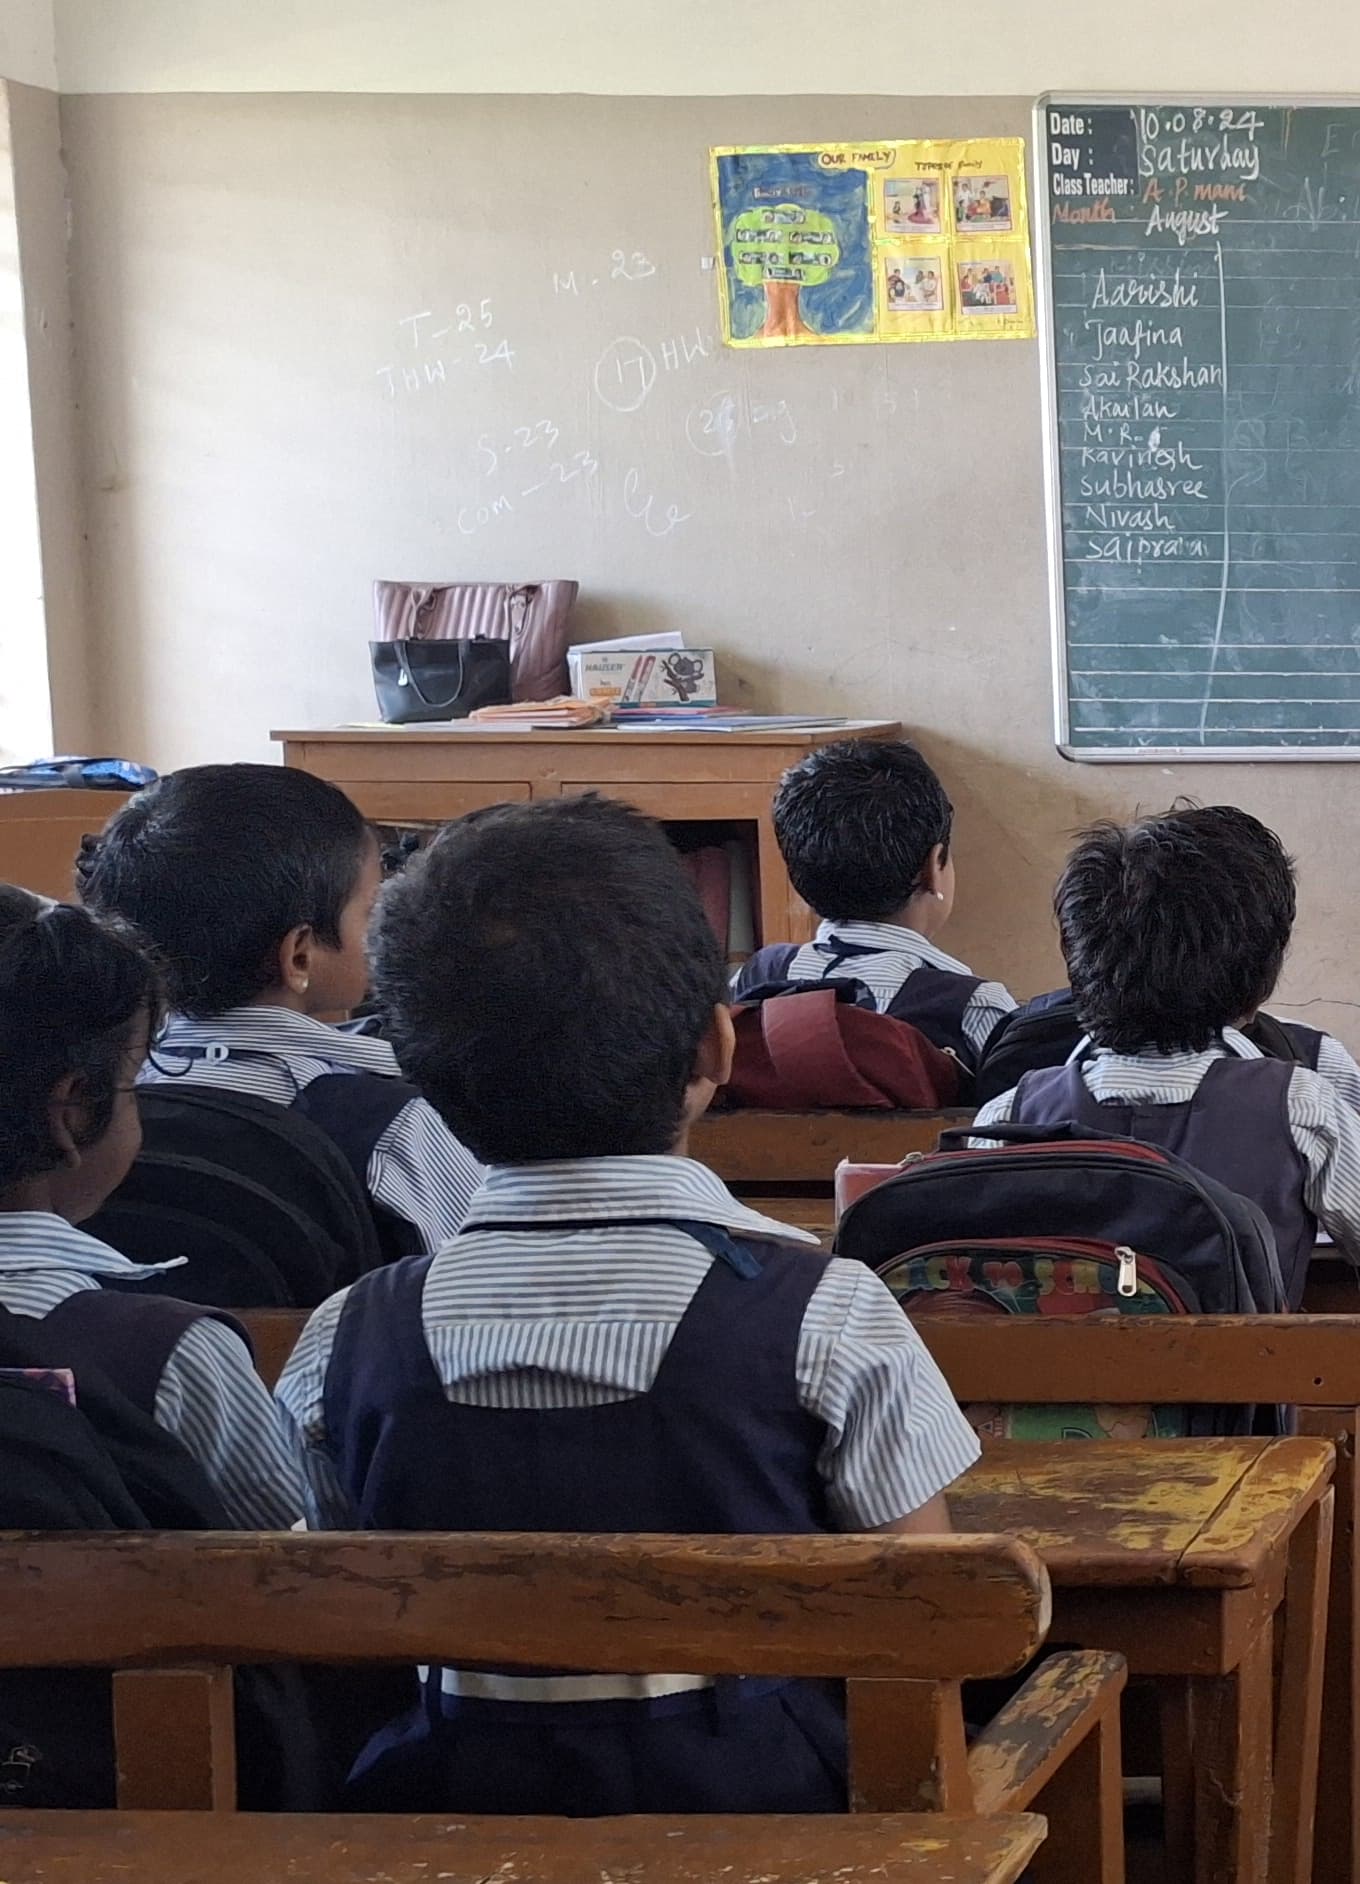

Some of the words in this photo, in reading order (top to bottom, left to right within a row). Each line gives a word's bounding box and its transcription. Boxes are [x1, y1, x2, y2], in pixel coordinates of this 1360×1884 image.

[1051, 142, 1080, 169] Day
[1053, 173, 1083, 196] Class
[1145, 202, 1230, 246] August
